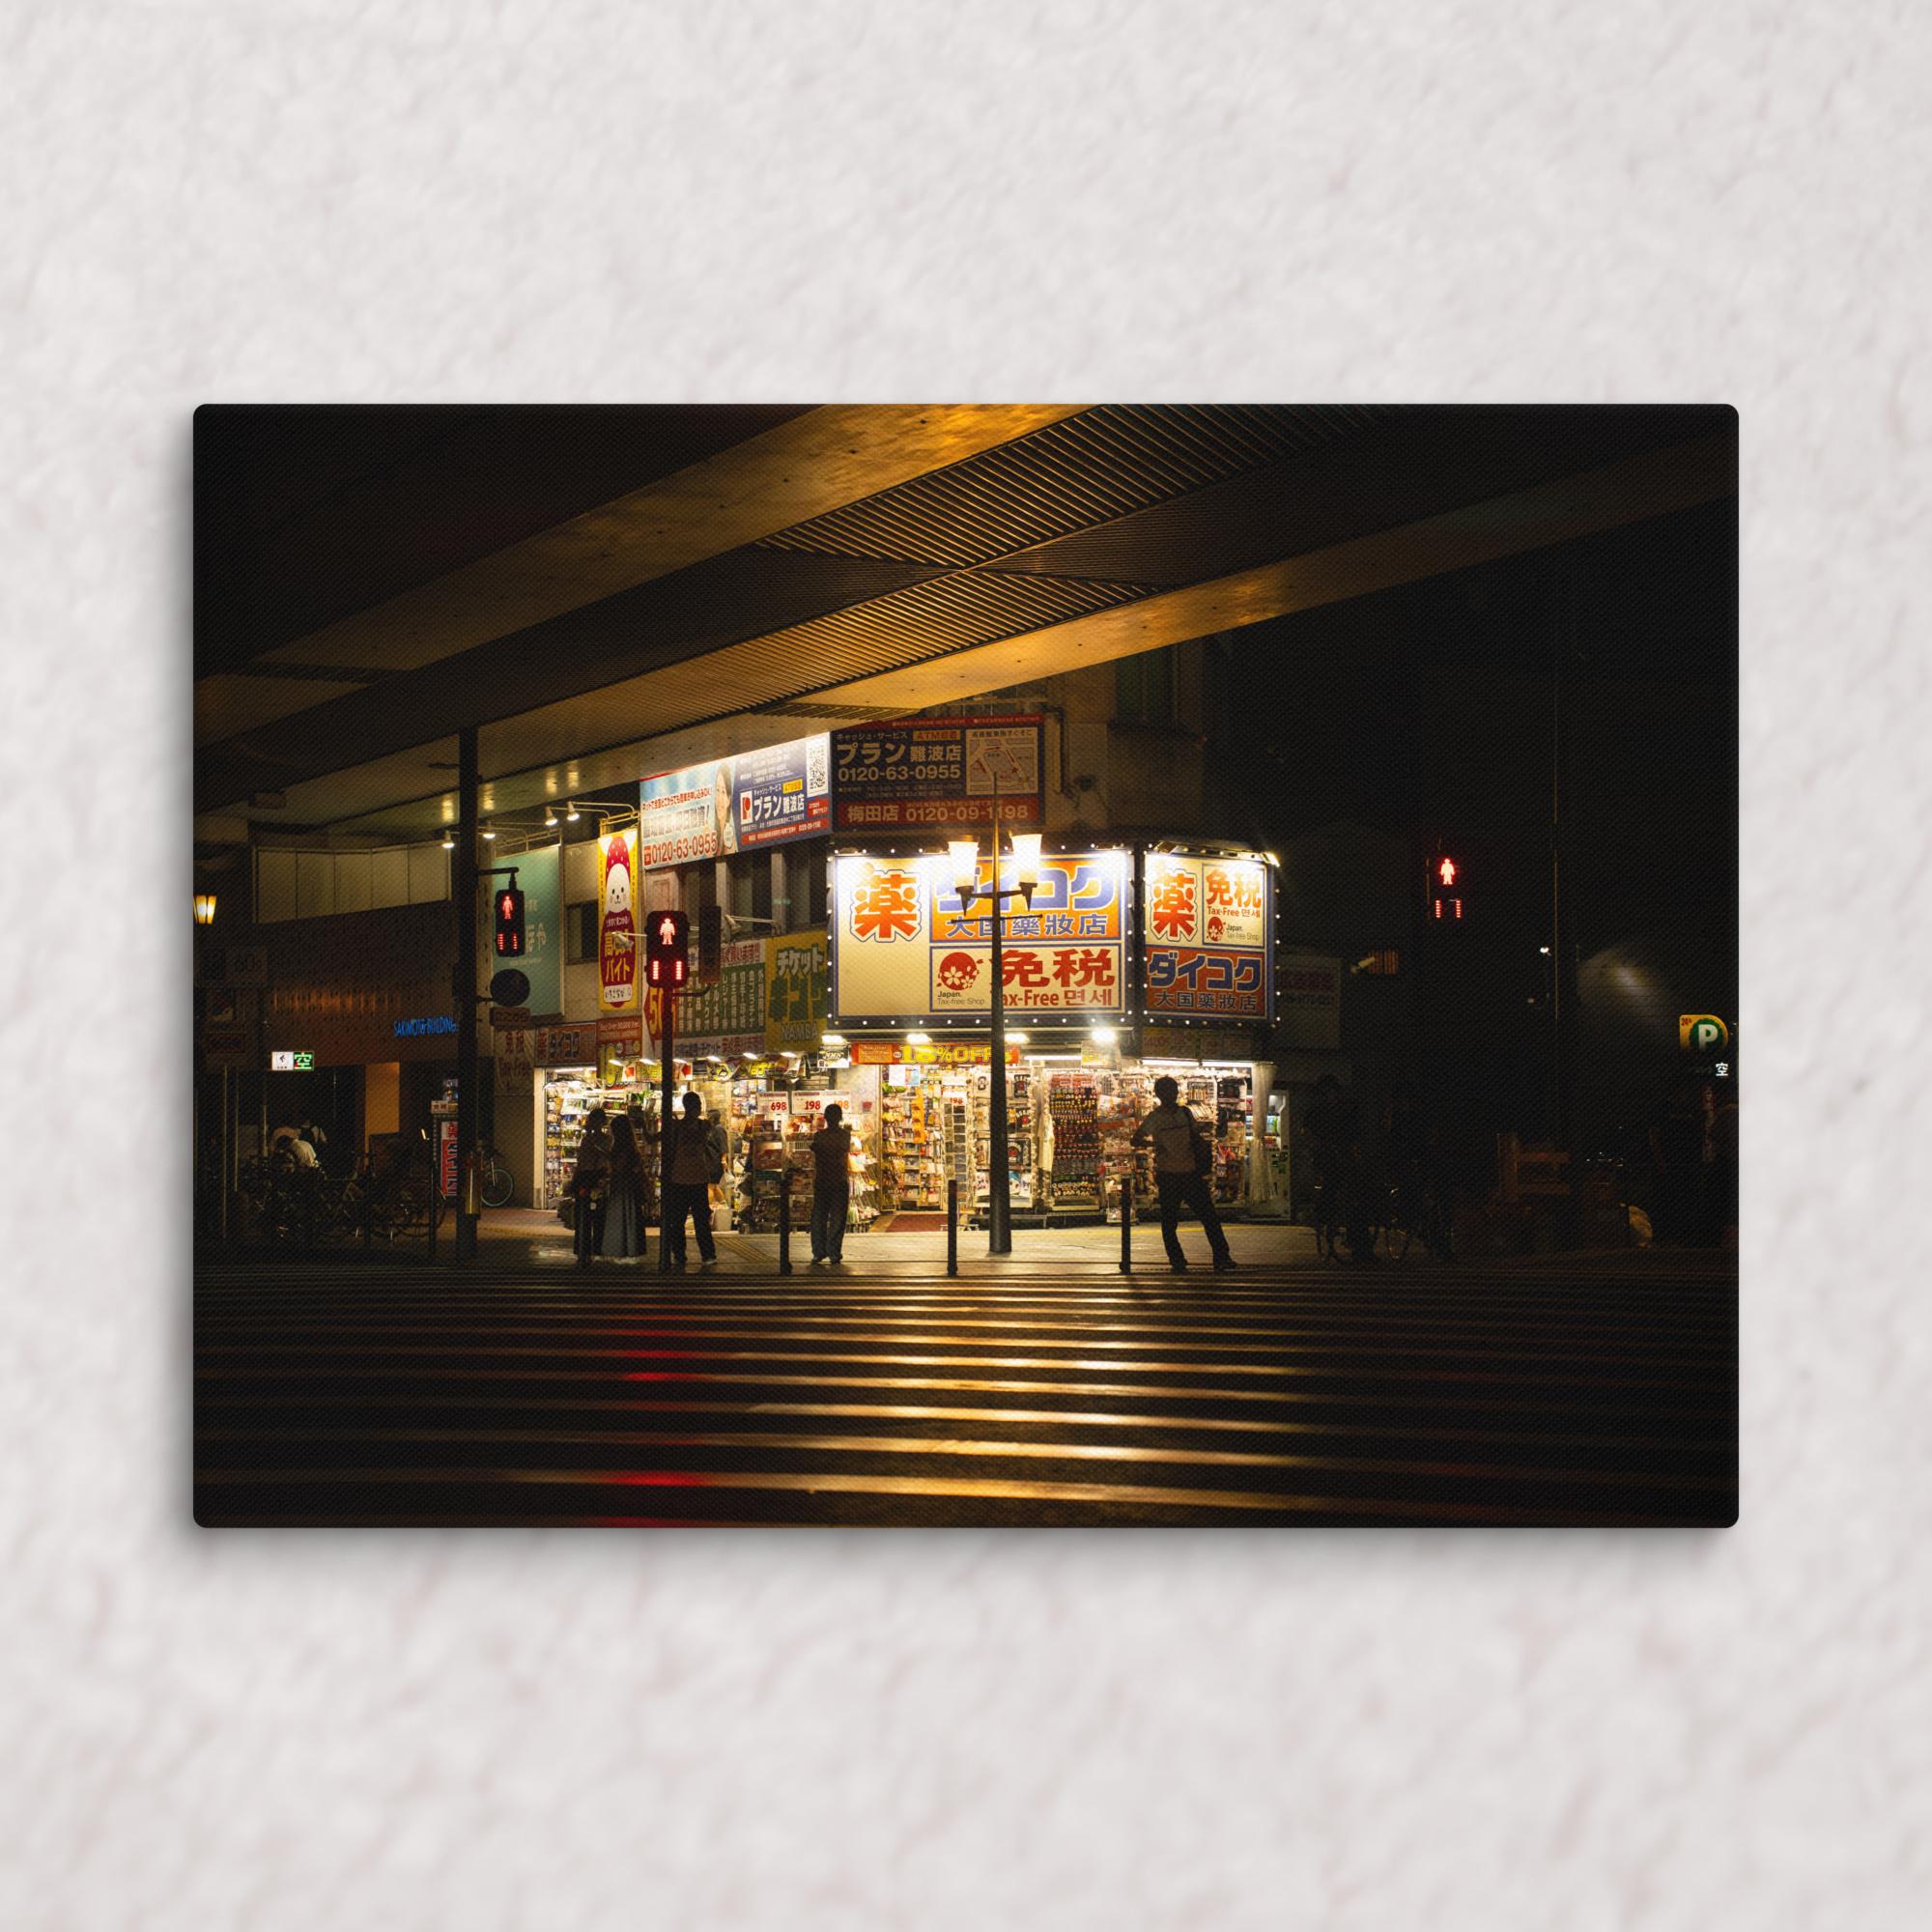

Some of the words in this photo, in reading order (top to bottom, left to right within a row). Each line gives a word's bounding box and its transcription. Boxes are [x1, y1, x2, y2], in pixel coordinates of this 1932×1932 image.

[837, 741, 906, 765] プラン
[910, 745, 962, 763] 難波店
[838, 765, 961, 781] 0120-63-0955
[753, 795, 782, 821] プラン
[847, 805, 900, 822] 梅田店
[906, 805, 1029, 822] 0120-09-1198
[651, 831, 717, 865] 0120-63-0955
[1206, 869, 1263, 909] 免税
[854, 871, 918, 939] 薬
[1152, 873, 1196, 938] 薬
[606, 956, 631, 982] バイト
[777, 944, 823, 977] チケット
[989, 949, 1116, 987] 免税
[1148, 950, 1263, 993] ダイコク
[992, 989, 1060, 1007] ax-Free
[1698, 1024, 1719, 1051] P
[1715, 1062, 1728, 1076] 空
[770, 1101, 787, 1111] 698
[804, 1099, 821, 1110] 198
[834, 1099, 849, 1109] 98
